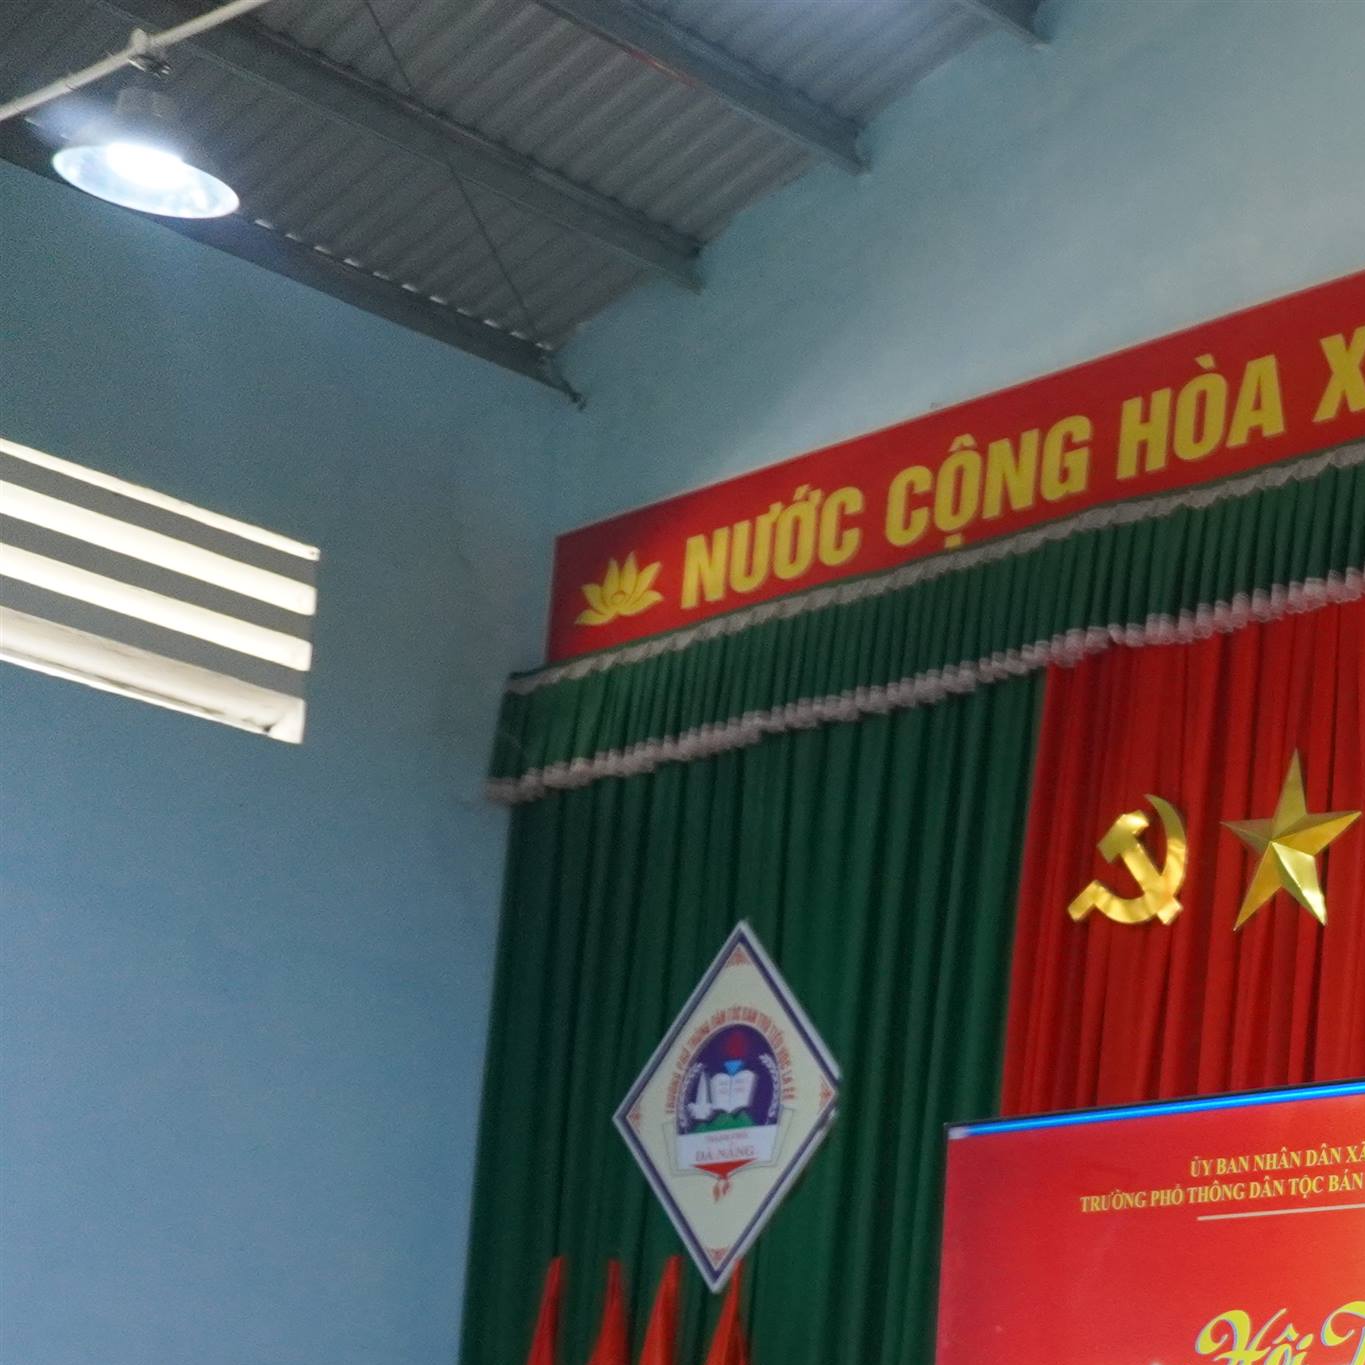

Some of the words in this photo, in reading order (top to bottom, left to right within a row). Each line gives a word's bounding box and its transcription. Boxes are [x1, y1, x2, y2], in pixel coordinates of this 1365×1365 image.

[680, 482, 866, 609] NƯỚC
[884, 414, 1092, 550] CỘNG
[1115, 351, 1285, 480] HÒA
[1215, 1156, 1250, 1176] BAN
[1253, 1146, 1303, 1171] NHÂN
[1305, 1142, 1342, 1167] DÂN
[1080, 1189, 1147, 1213] TRƯỜNG
[1187, 1179, 1245, 1204] THÔNG
[1249, 1175, 1285, 1199] DÂN
[1288, 1175, 1325, 1199] TỘC
[1328, 1168, 1364, 1193] BÁN
